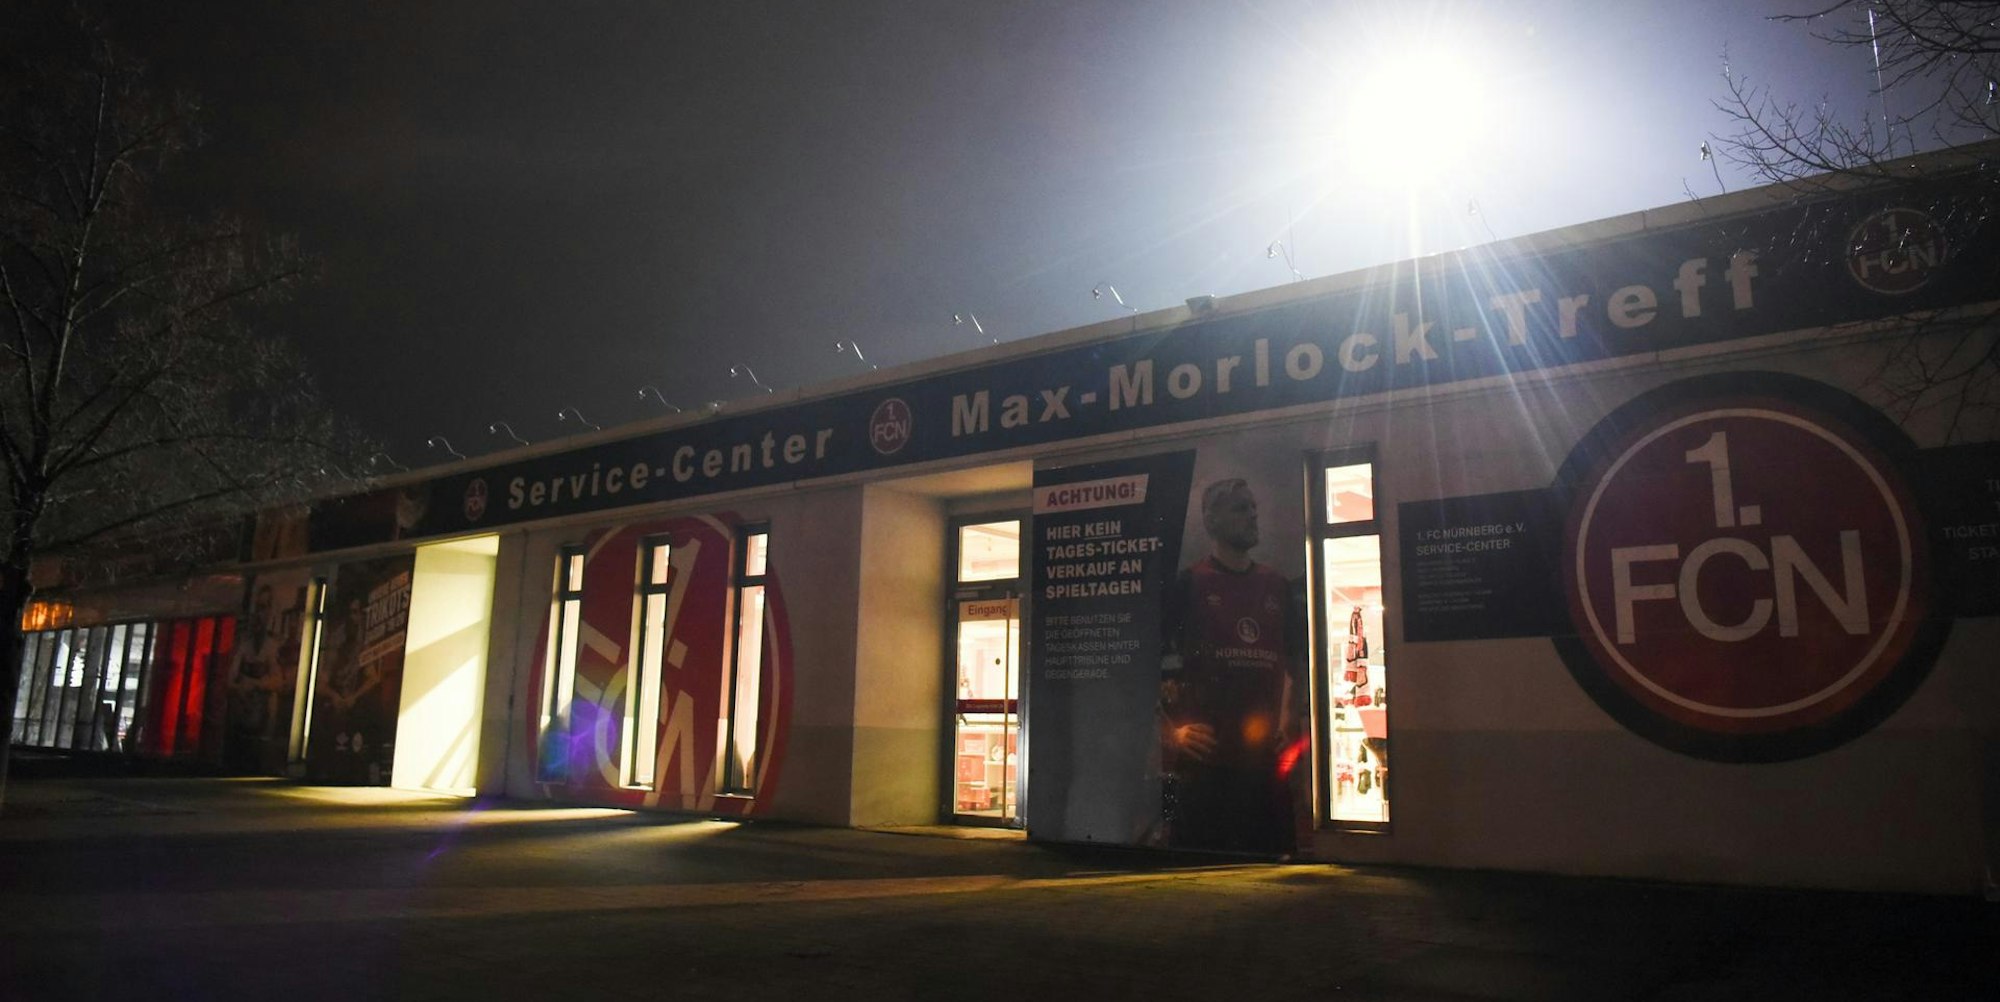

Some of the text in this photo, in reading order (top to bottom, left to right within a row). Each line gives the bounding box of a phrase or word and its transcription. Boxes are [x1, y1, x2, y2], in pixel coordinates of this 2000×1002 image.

[951, 249, 1761, 437] Max-Morlock-Treff
[874, 419, 907, 443] FCN
[508, 427, 834, 510] Service-Center
[1686, 431, 1762, 528] 1.
[1046, 482, 1136, 507] ACHTUNG!
[1047, 520, 1122, 540] HIER KEIN
[1426, 529, 1441, 540] FC
[1442, 523, 1504, 538] NÜRNBERG
[1047, 538, 1164, 560] TAGES-TICKET-
[1416, 538, 1511, 556] SERVICE-CENTER
[1046, 559, 1143, 579] VERKAUF AN
[1045, 579, 1143, 600] SPIELTAGEN
[1611, 529, 1871, 645] FCN
[1045, 612, 1132, 626] BITTE BENUTZEN SIE
[1107, 640, 1140, 650] HINTER
[1110, 654, 1132, 665] UND
